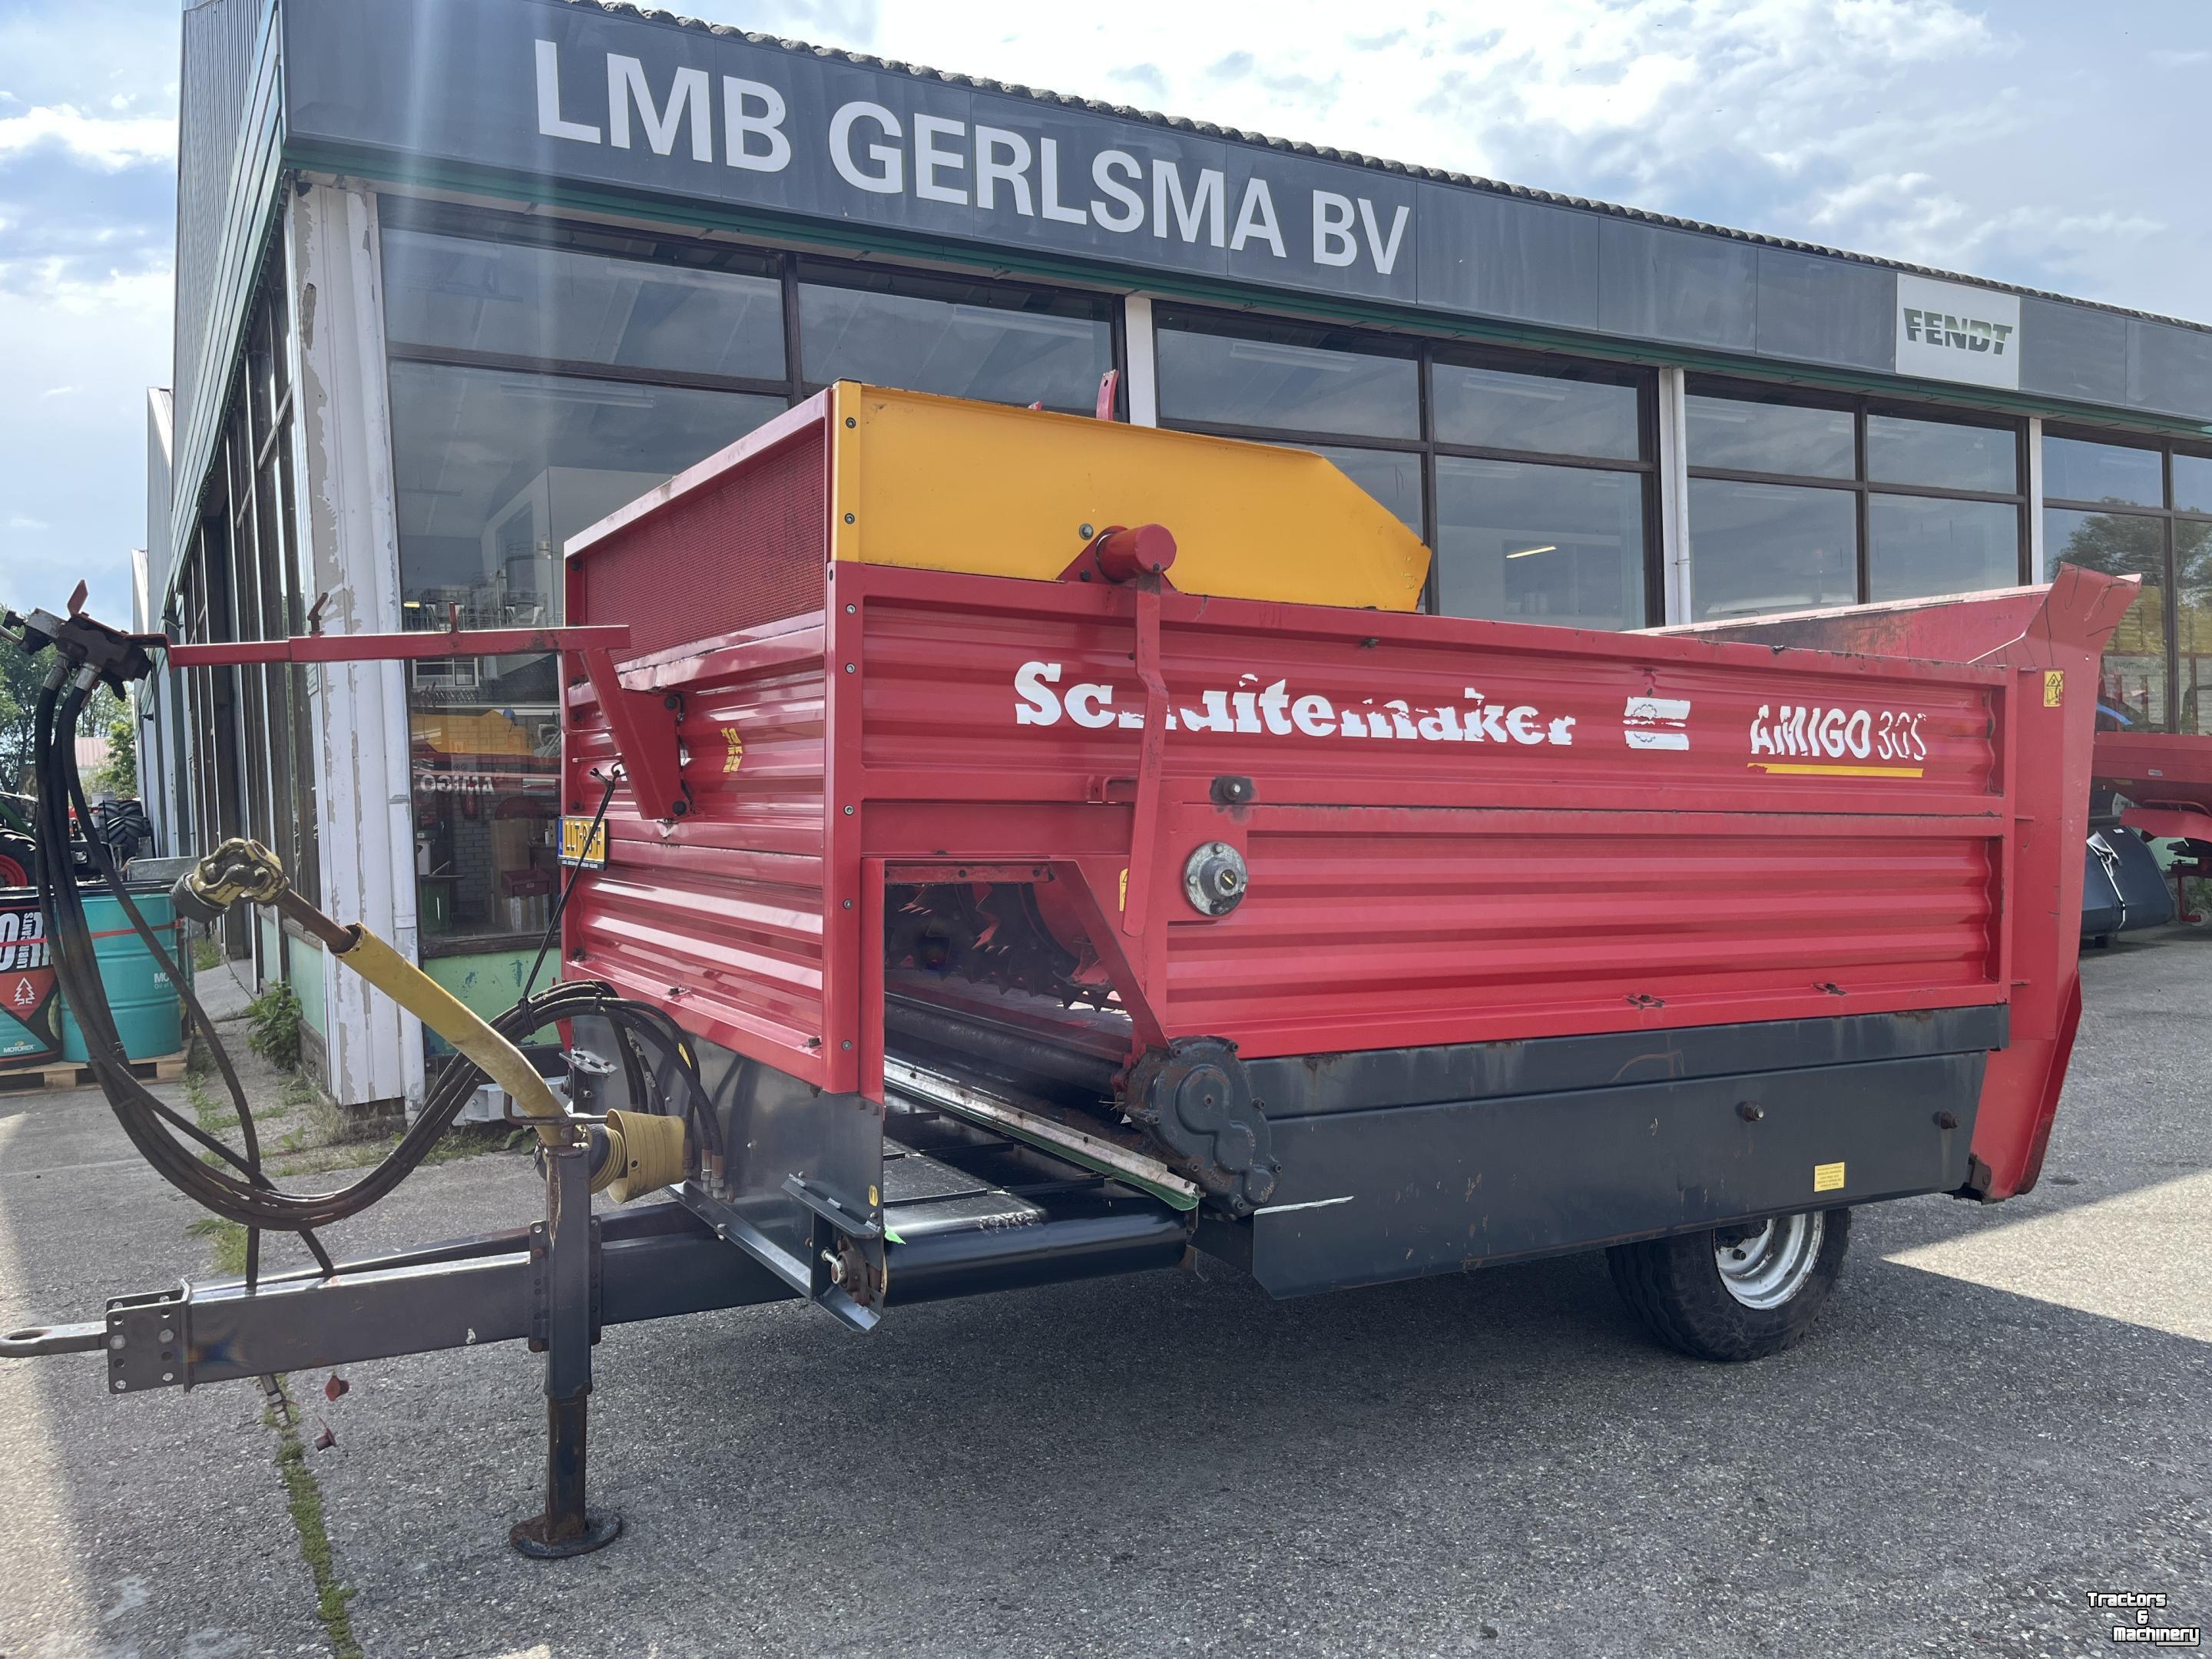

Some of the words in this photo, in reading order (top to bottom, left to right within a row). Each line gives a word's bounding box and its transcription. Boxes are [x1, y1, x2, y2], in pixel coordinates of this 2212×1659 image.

[535, 39, 792, 173] LMB
[829, 101, 1287, 258] GERLSMA
[1313, 190, 1410, 276] BV
[1903, 307, 2013, 356] FENDT
[1014, 661, 1575, 746] Scuitemaker
[1750, 704, 1872, 759] AMIGO
[16, 912, 34, 969] LUBRCANTS
